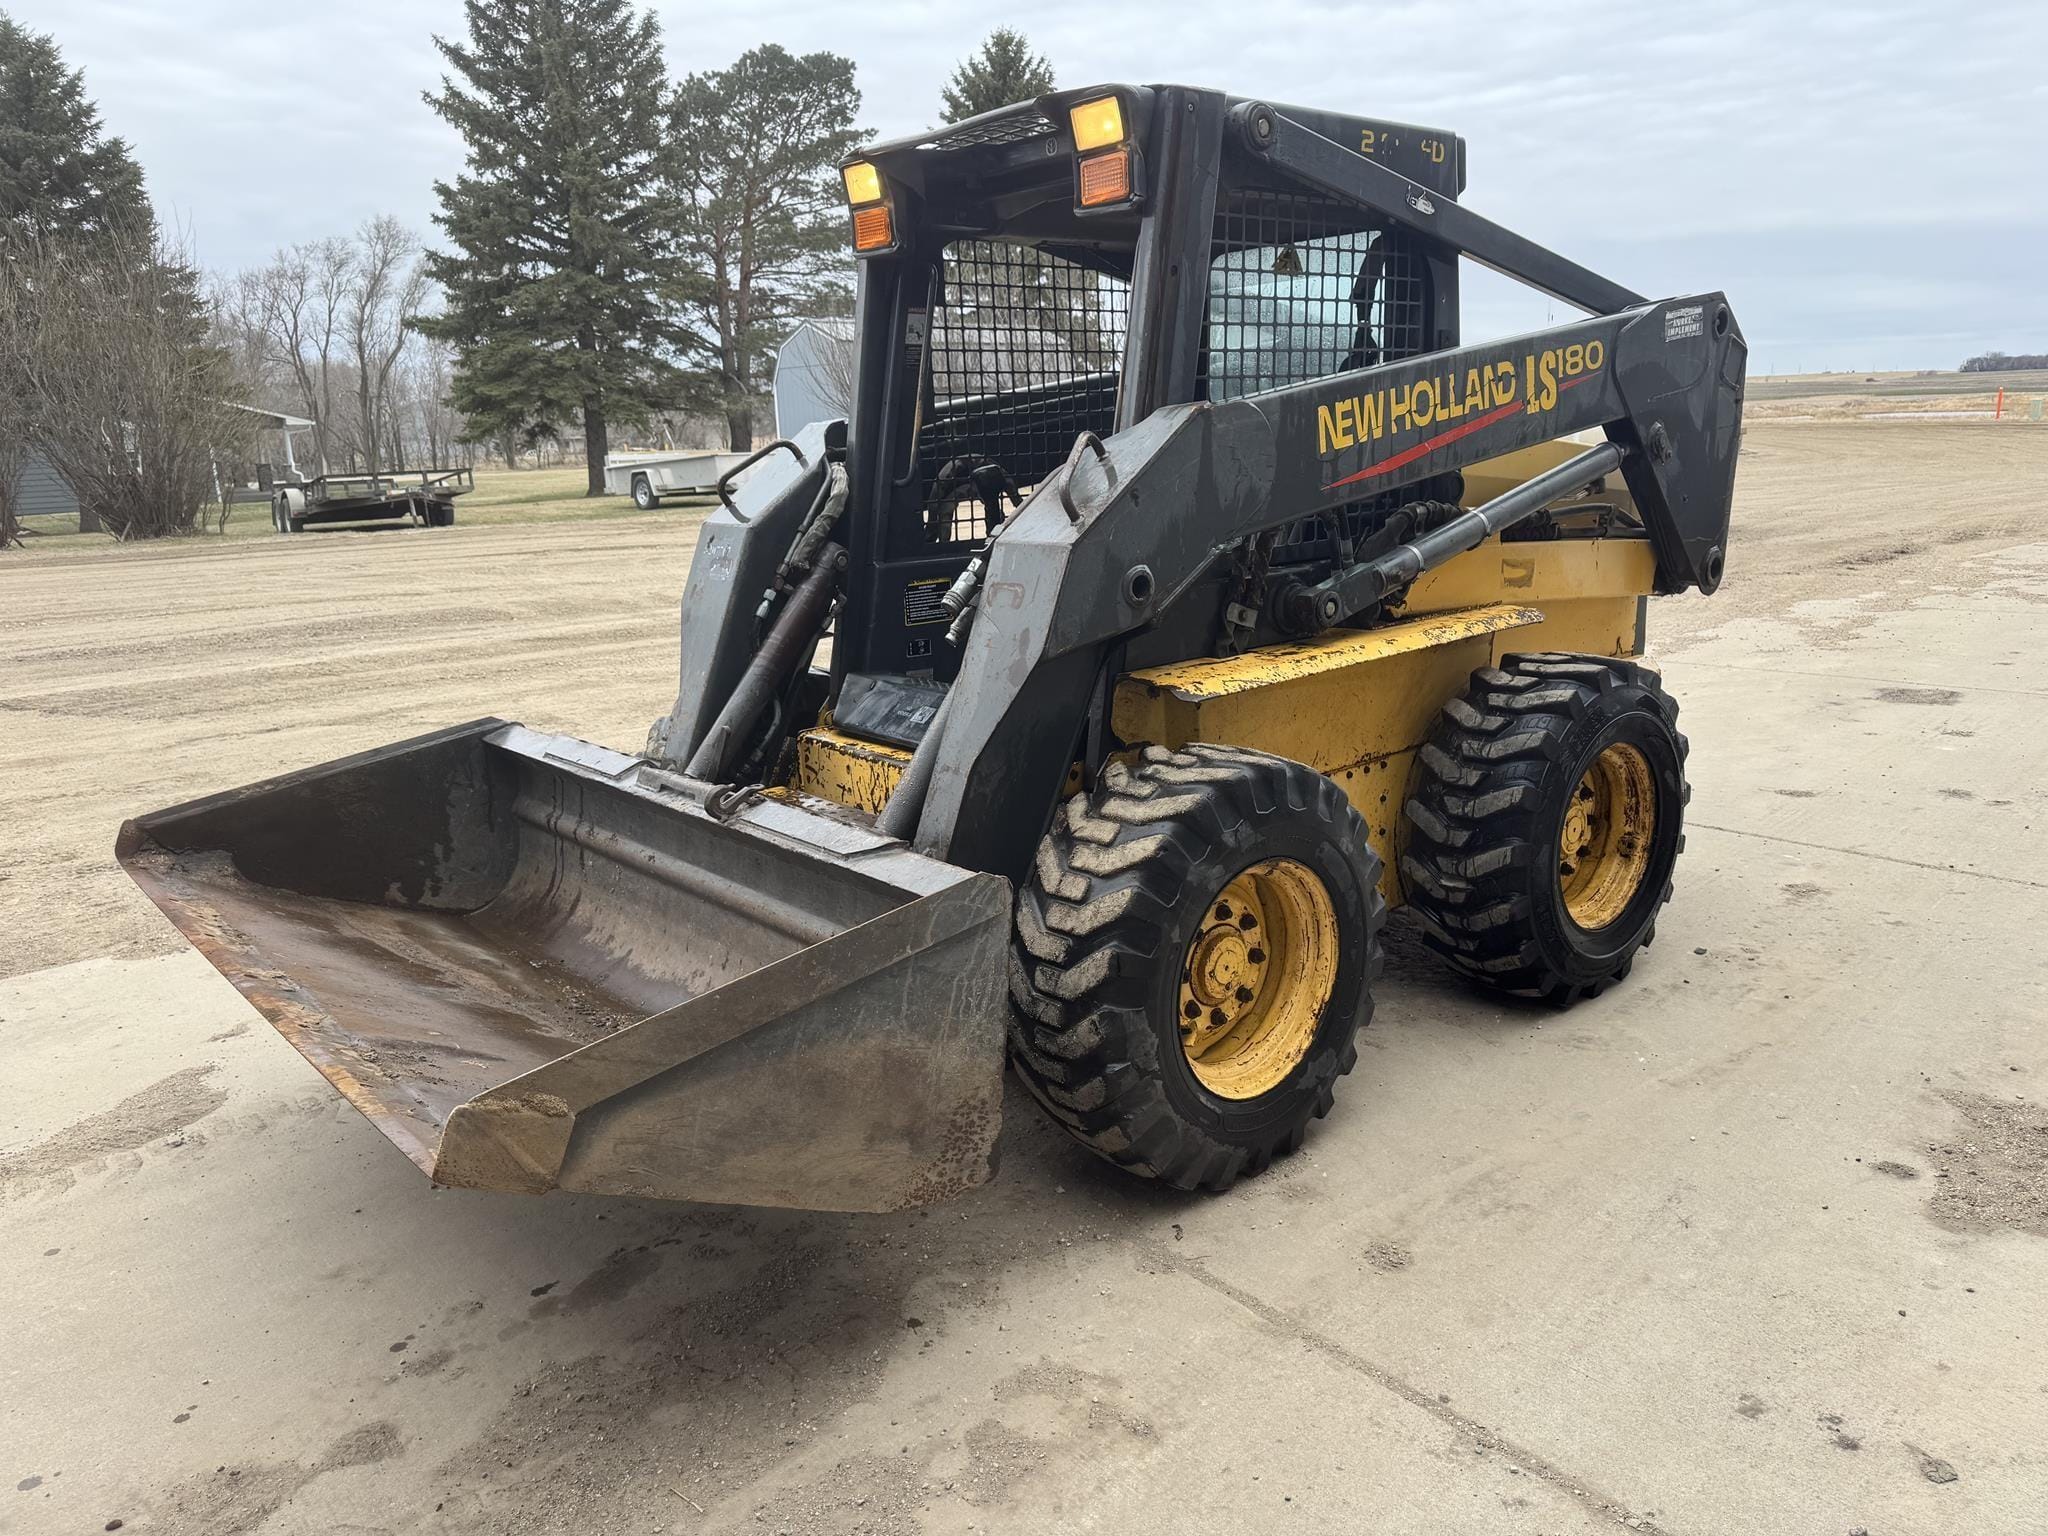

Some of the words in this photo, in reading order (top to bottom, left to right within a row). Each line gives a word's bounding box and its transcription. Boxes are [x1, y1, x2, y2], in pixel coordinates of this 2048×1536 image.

[1361, 129, 1375, 153] 2
[1317, 391, 1385, 454] NEW
[1390, 360, 1517, 434] HOLLAND
